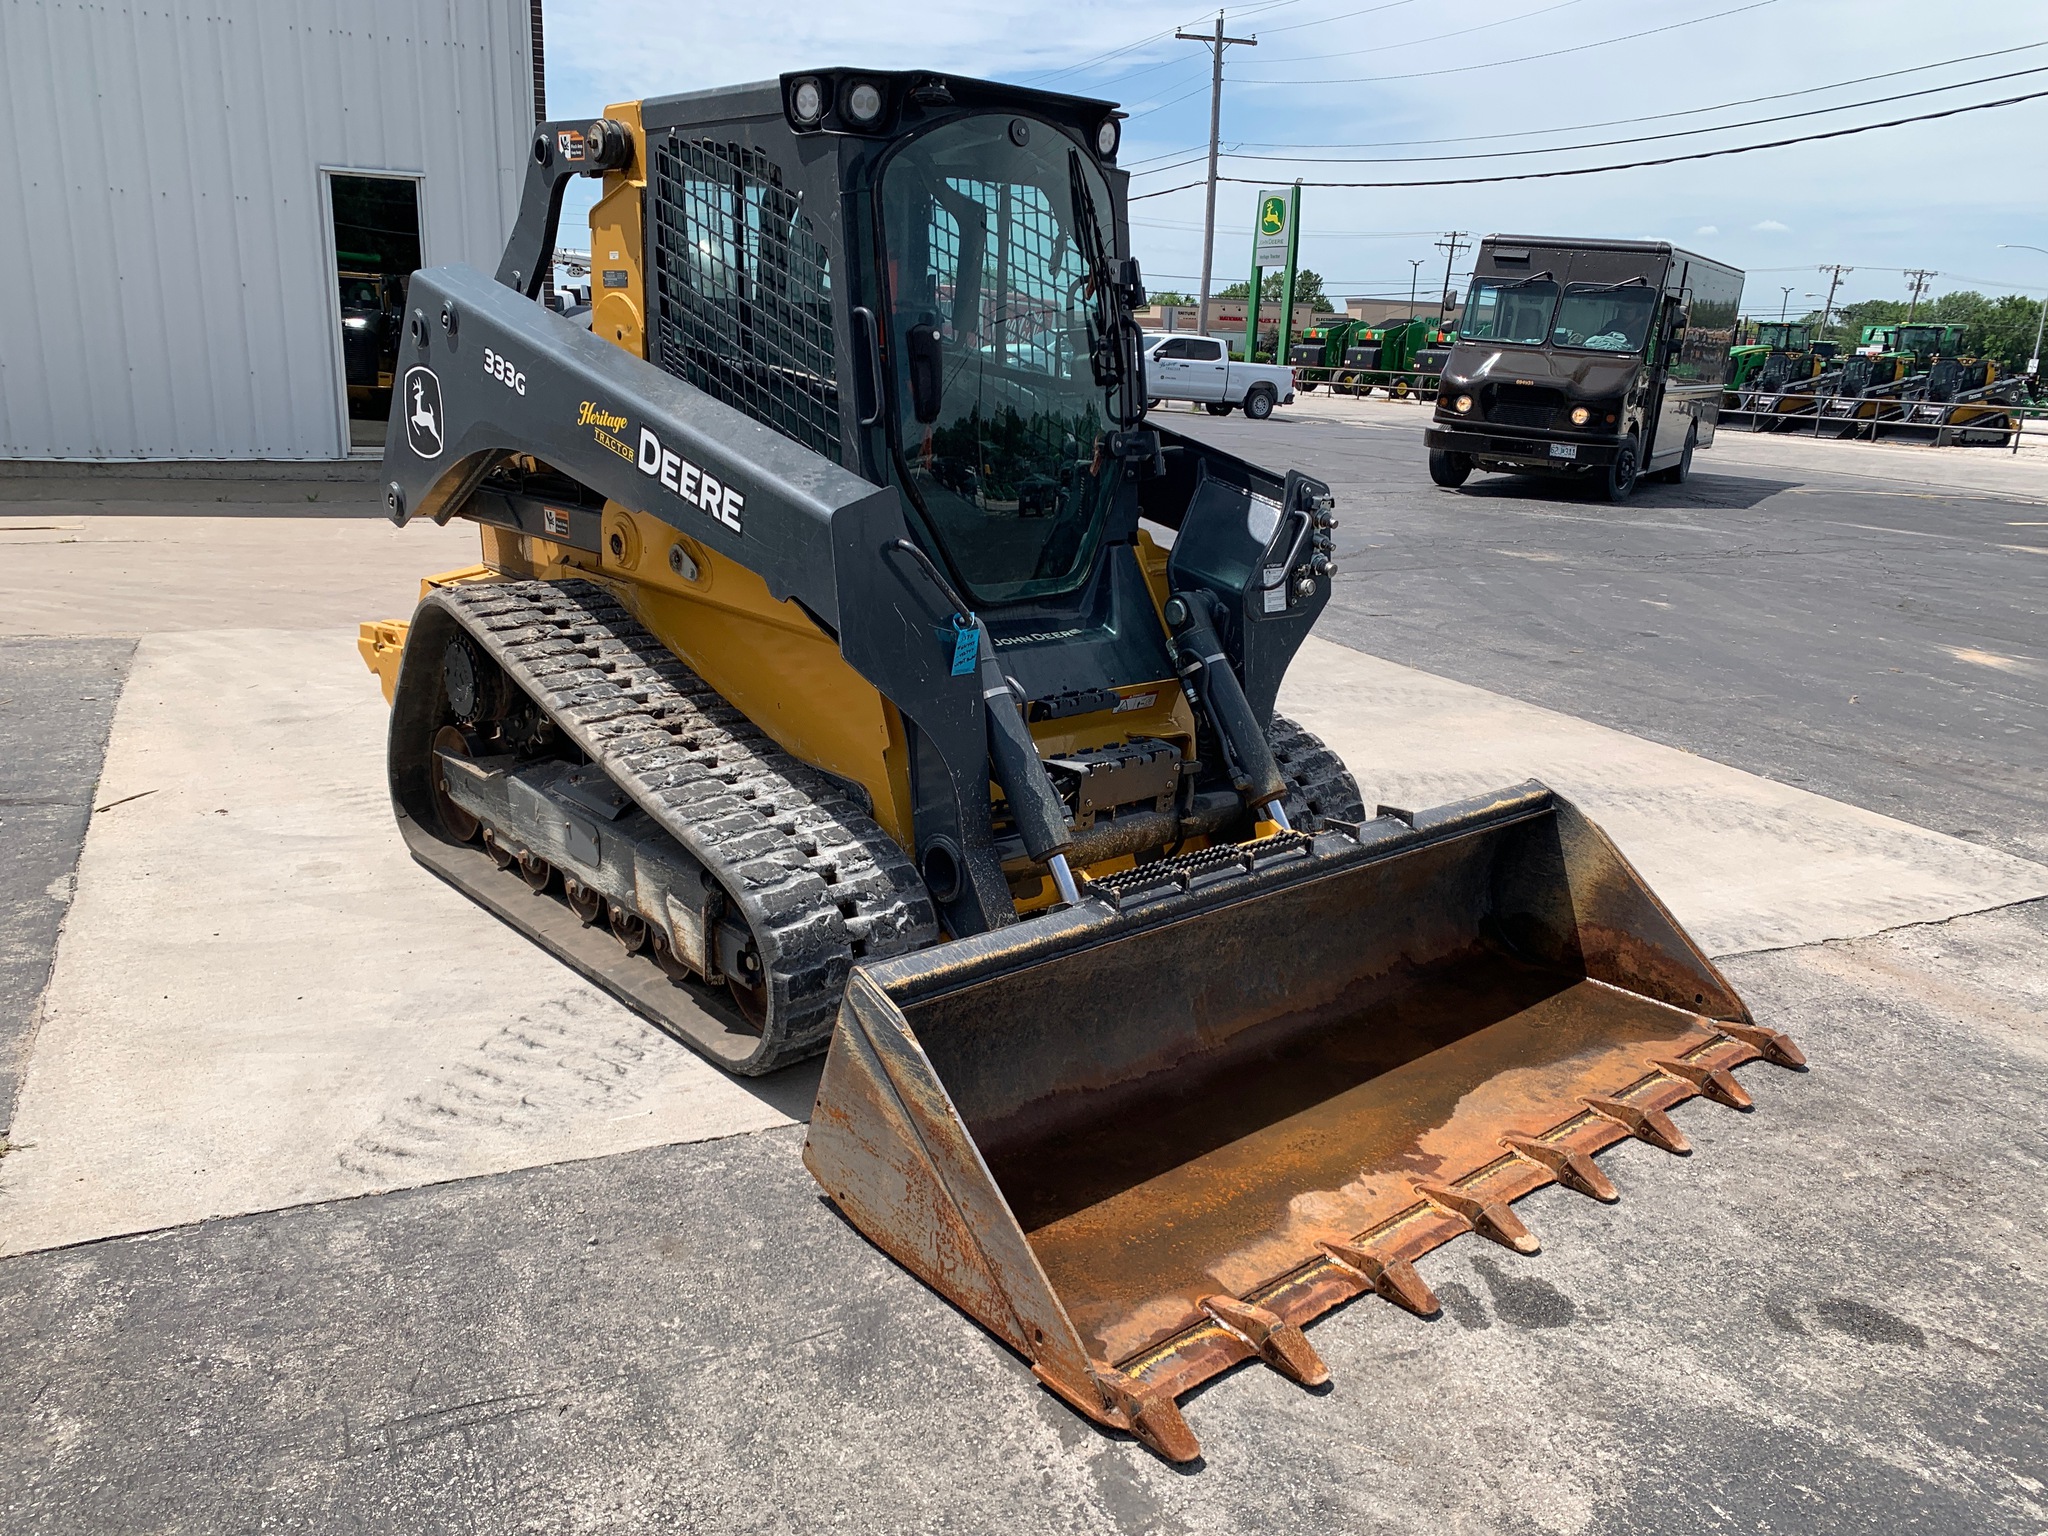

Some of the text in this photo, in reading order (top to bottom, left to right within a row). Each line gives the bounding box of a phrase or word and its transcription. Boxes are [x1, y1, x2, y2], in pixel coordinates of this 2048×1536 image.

[484, 348, 526, 396] 333G
[577, 400, 628, 434] Heritage
[594, 429, 635, 461] TRACTOR
[638, 426, 744, 533] DEERE
[993, 628, 1083, 646] JOHN DEERE
